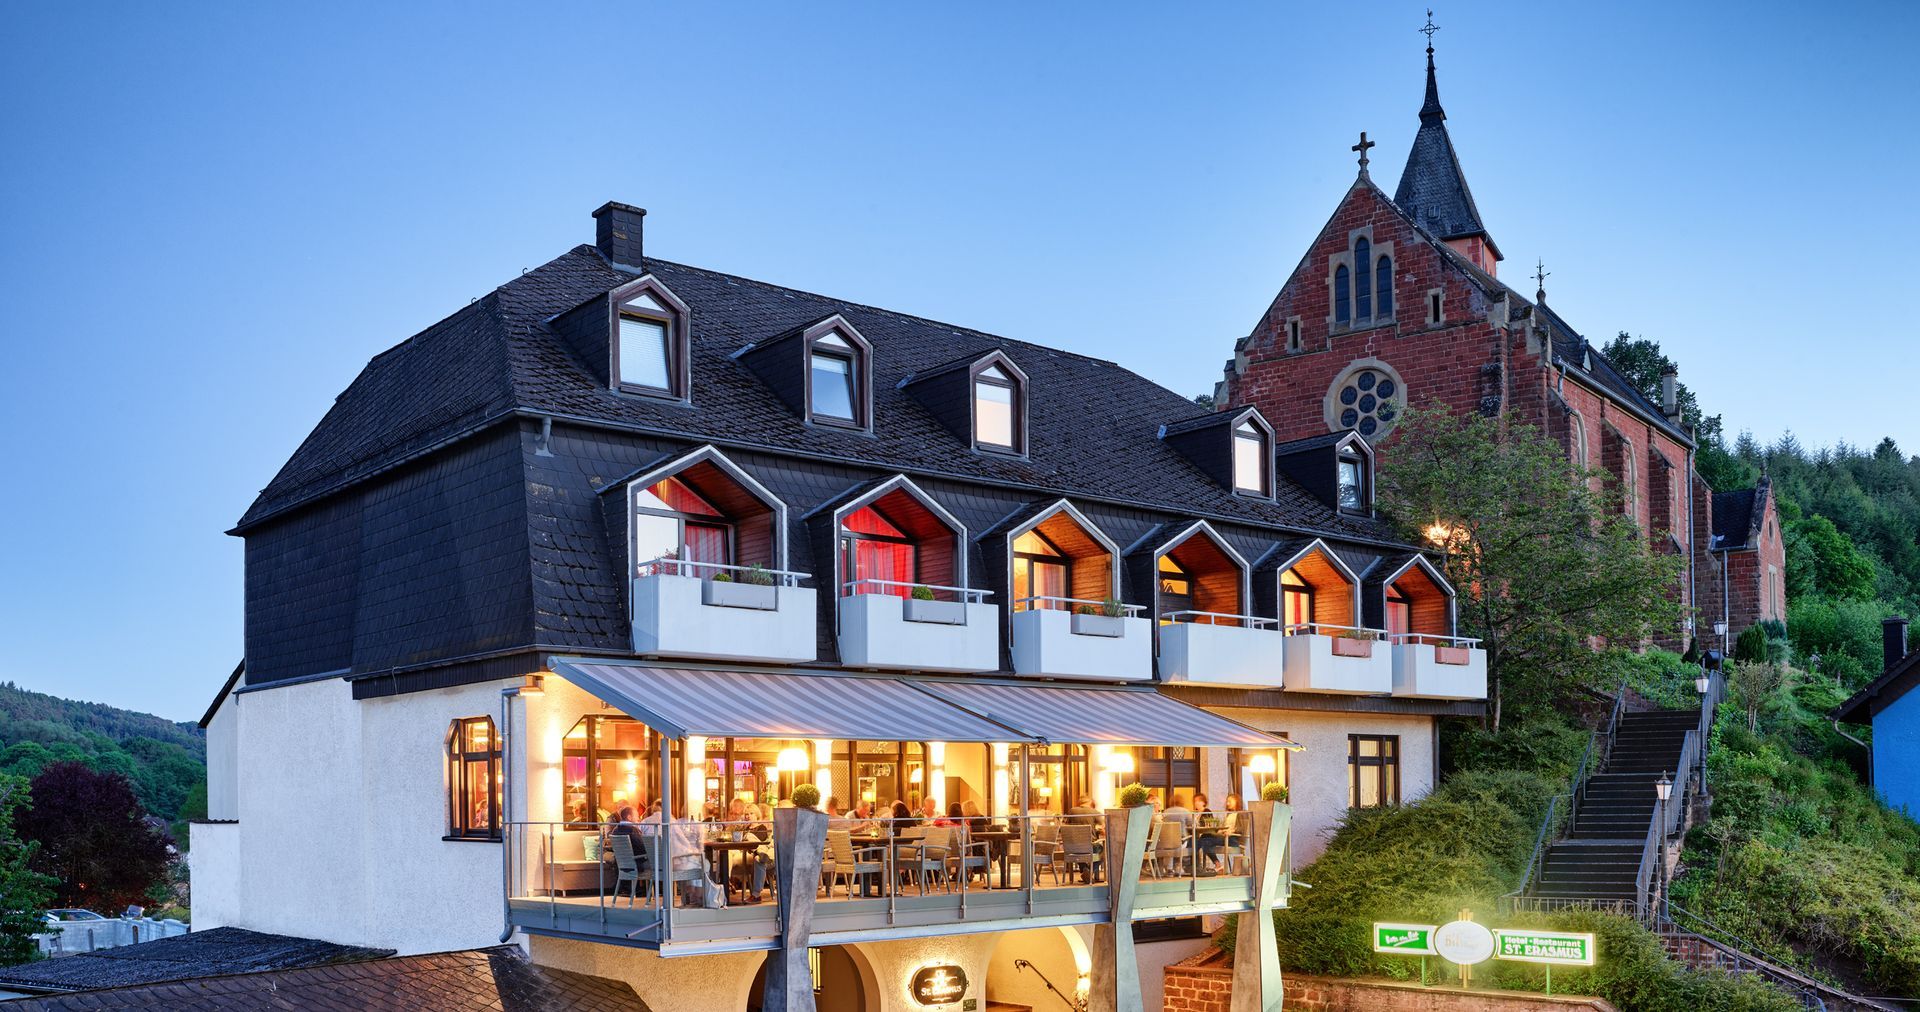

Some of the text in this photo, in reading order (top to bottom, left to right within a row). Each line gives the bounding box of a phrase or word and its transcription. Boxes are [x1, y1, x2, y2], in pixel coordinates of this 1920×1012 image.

[1505, 936, 1582, 947] Hotel Restaurant
[1505, 944, 1582, 959] ST. ERASMUS
[932, 985, 962, 996] EMUS
